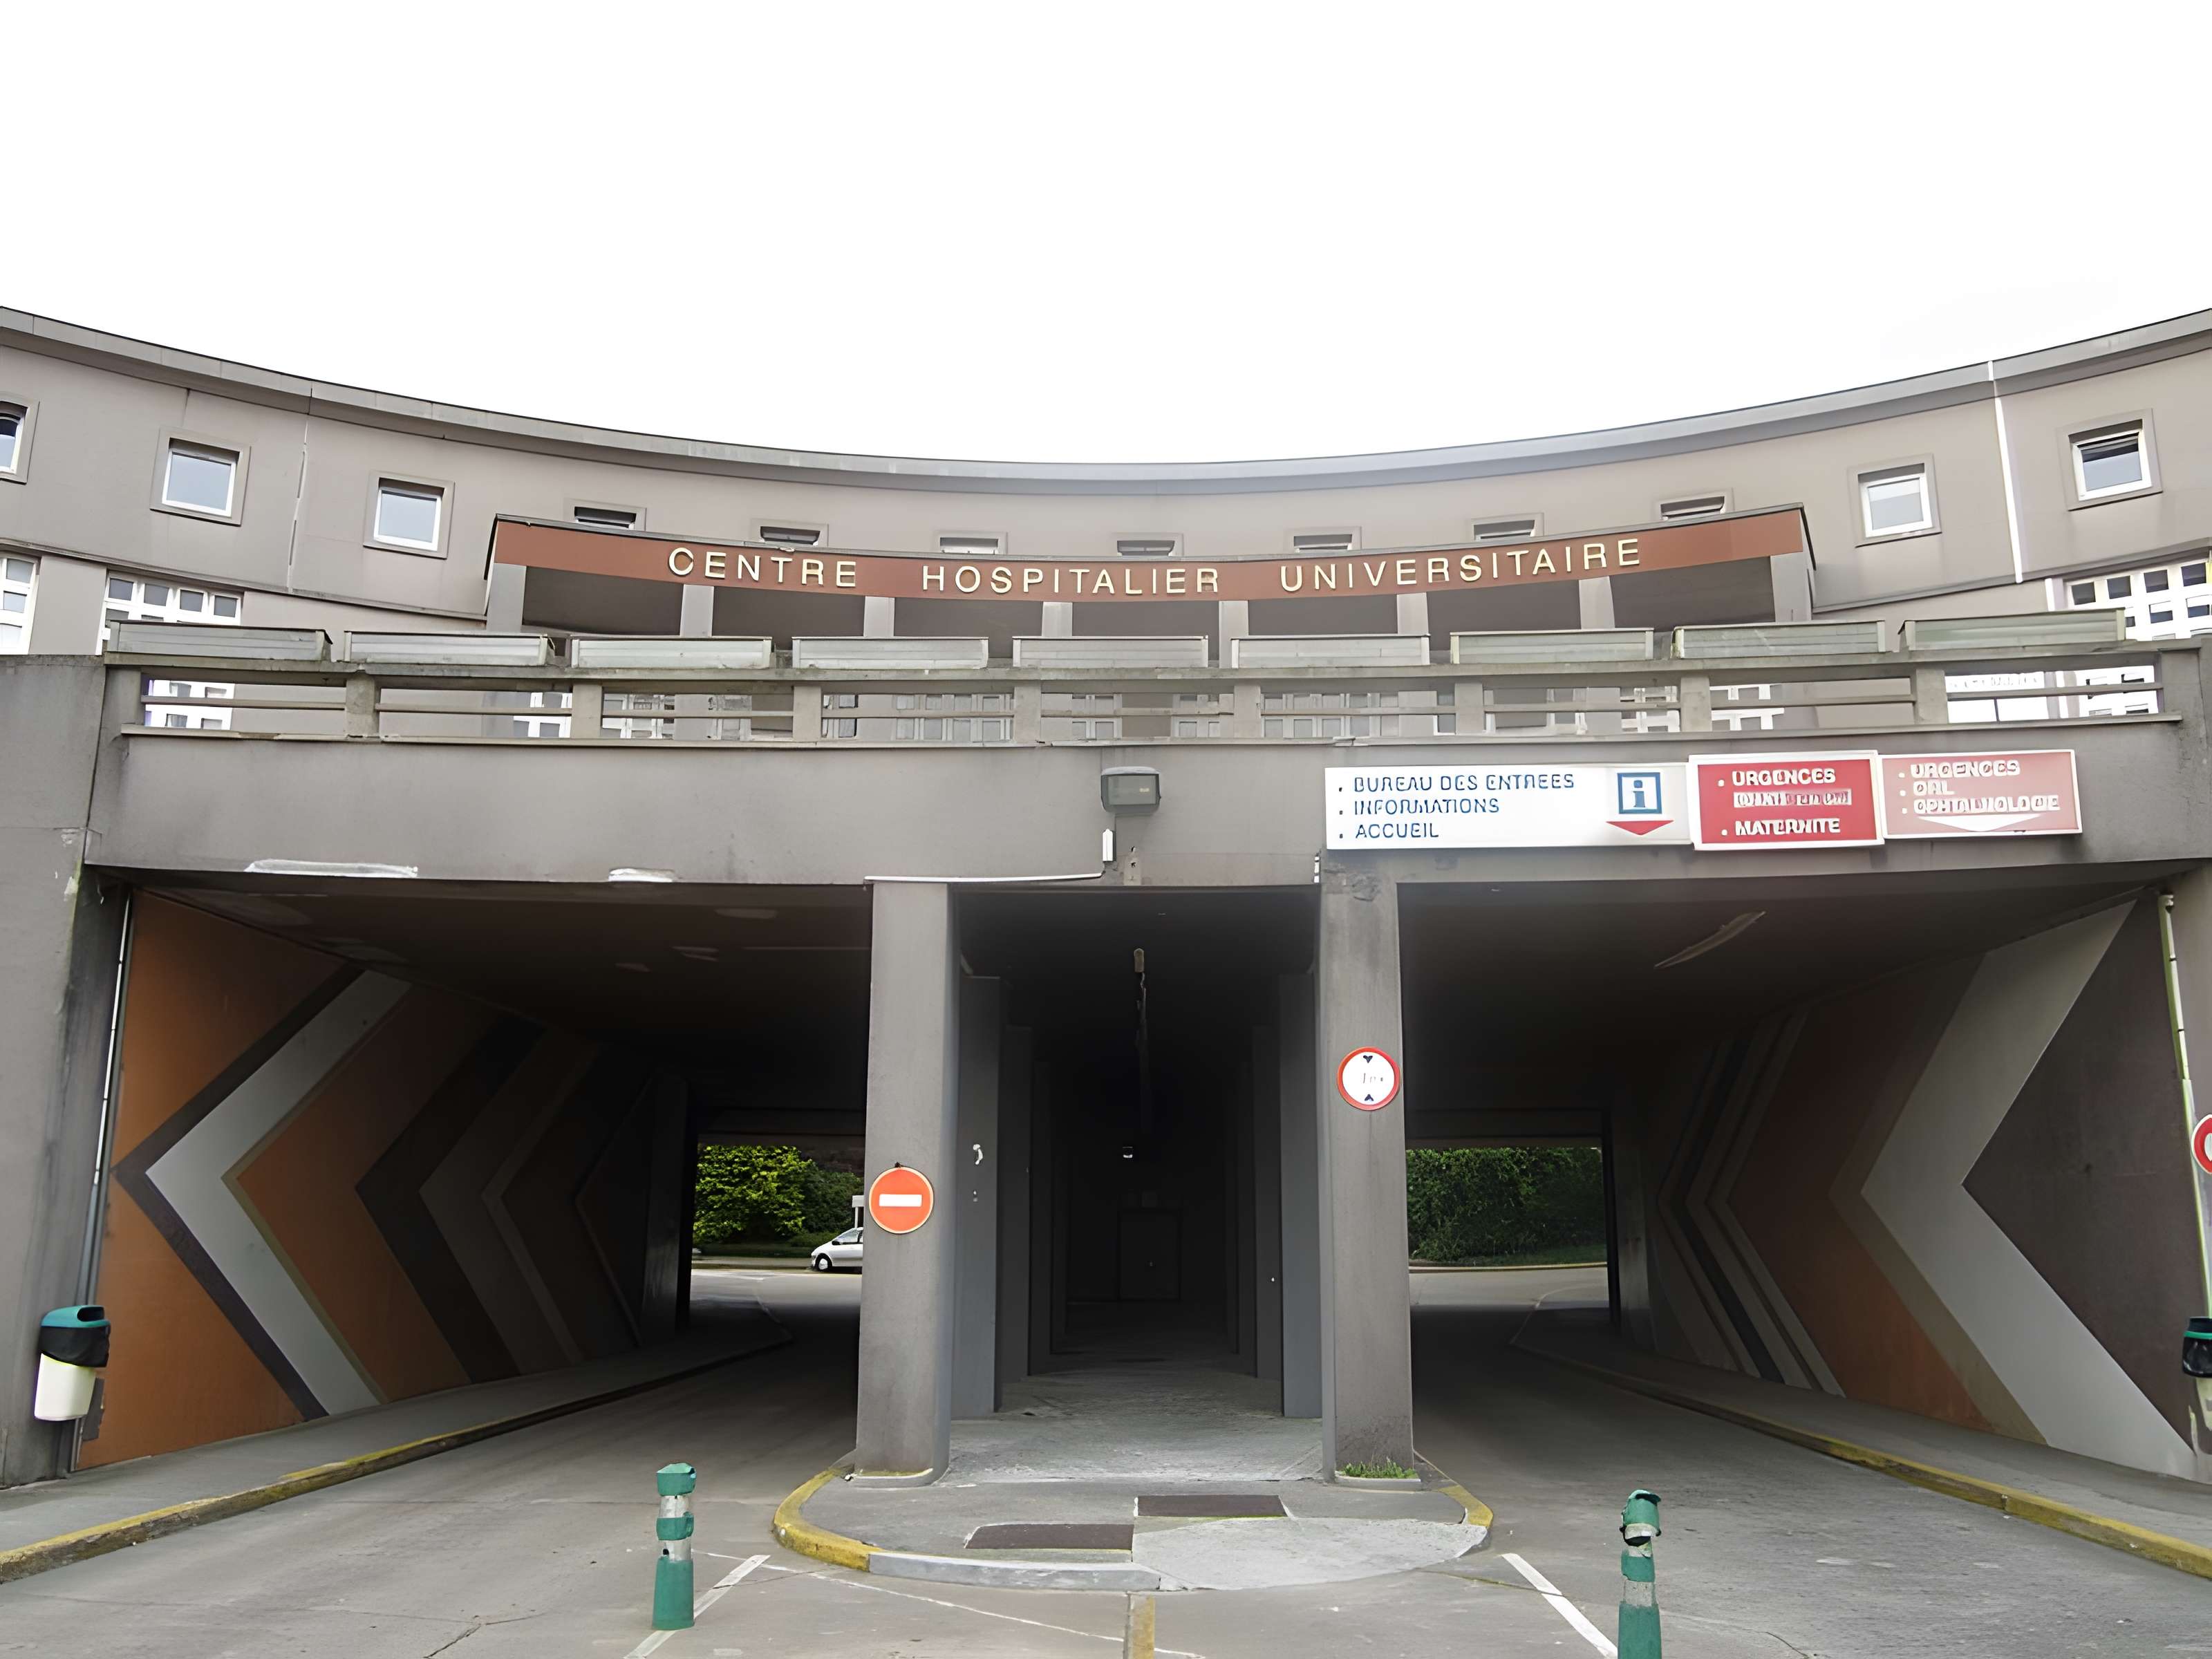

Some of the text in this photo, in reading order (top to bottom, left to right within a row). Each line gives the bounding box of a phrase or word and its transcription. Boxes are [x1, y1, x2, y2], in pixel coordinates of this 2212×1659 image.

[668, 538, 1640, 594] CENTRE HOSPITALIER UNIVERSITAIRE
[1732, 768, 1837, 787] URGENCES
[1910, 760, 2021, 778] URGENCES
[1353, 774, 1575, 792] BUREAU DES ENTREES
[1353, 798, 1500, 815] INFORMATIONS
[1355, 822, 1440, 839] ACCUEIL
